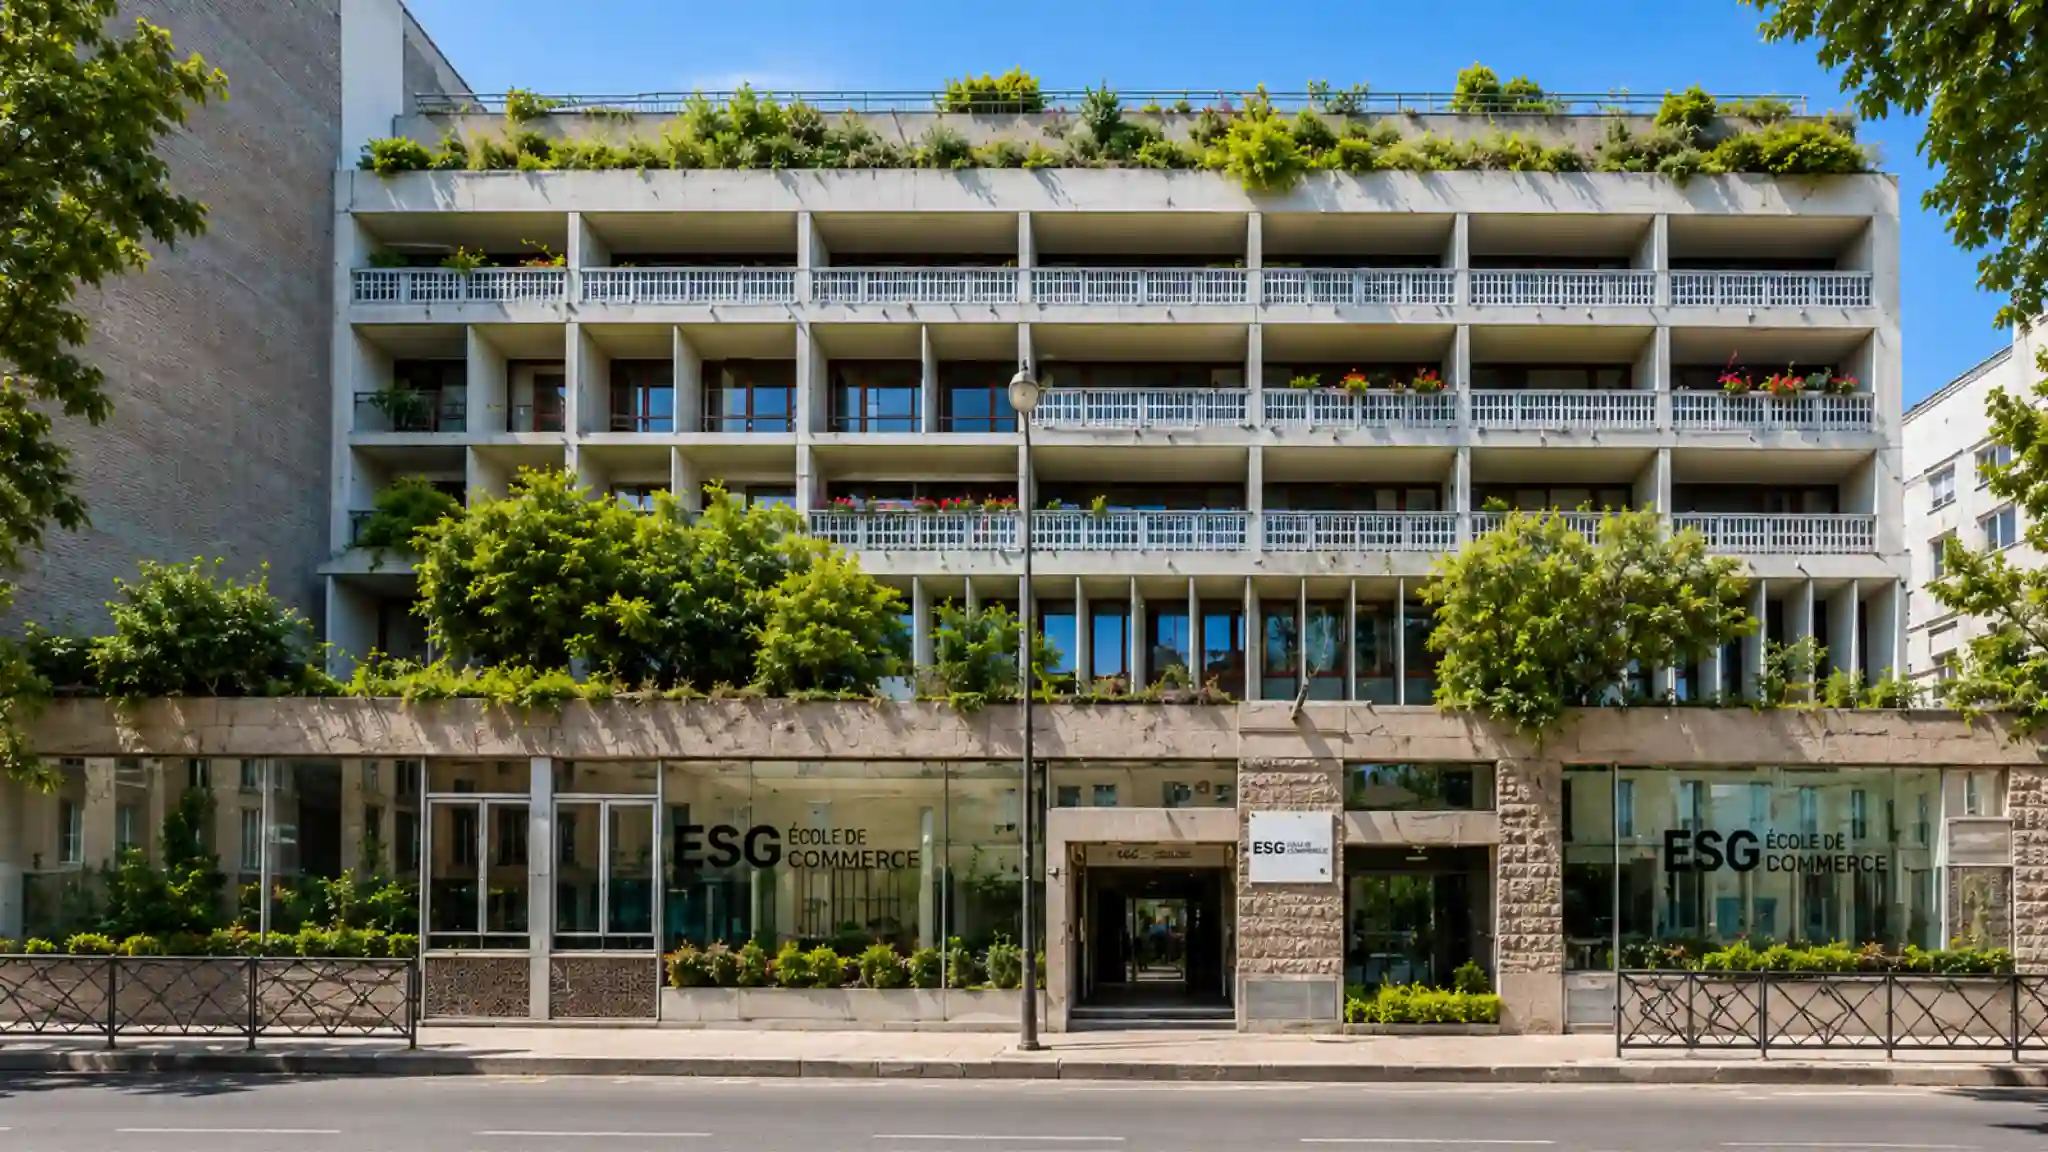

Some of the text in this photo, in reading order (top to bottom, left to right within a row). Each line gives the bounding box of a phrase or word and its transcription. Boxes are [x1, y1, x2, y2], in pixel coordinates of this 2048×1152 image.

[788, 823, 866, 845] ÉCOLE DE
[1766, 828, 1845, 850] ÉCOLE DE
[673, 825, 781, 869] ESG
[1253, 841, 1285, 854] ESG
[1664, 829, 1760, 872] ESG
[788, 850, 920, 869] COMMERCE
